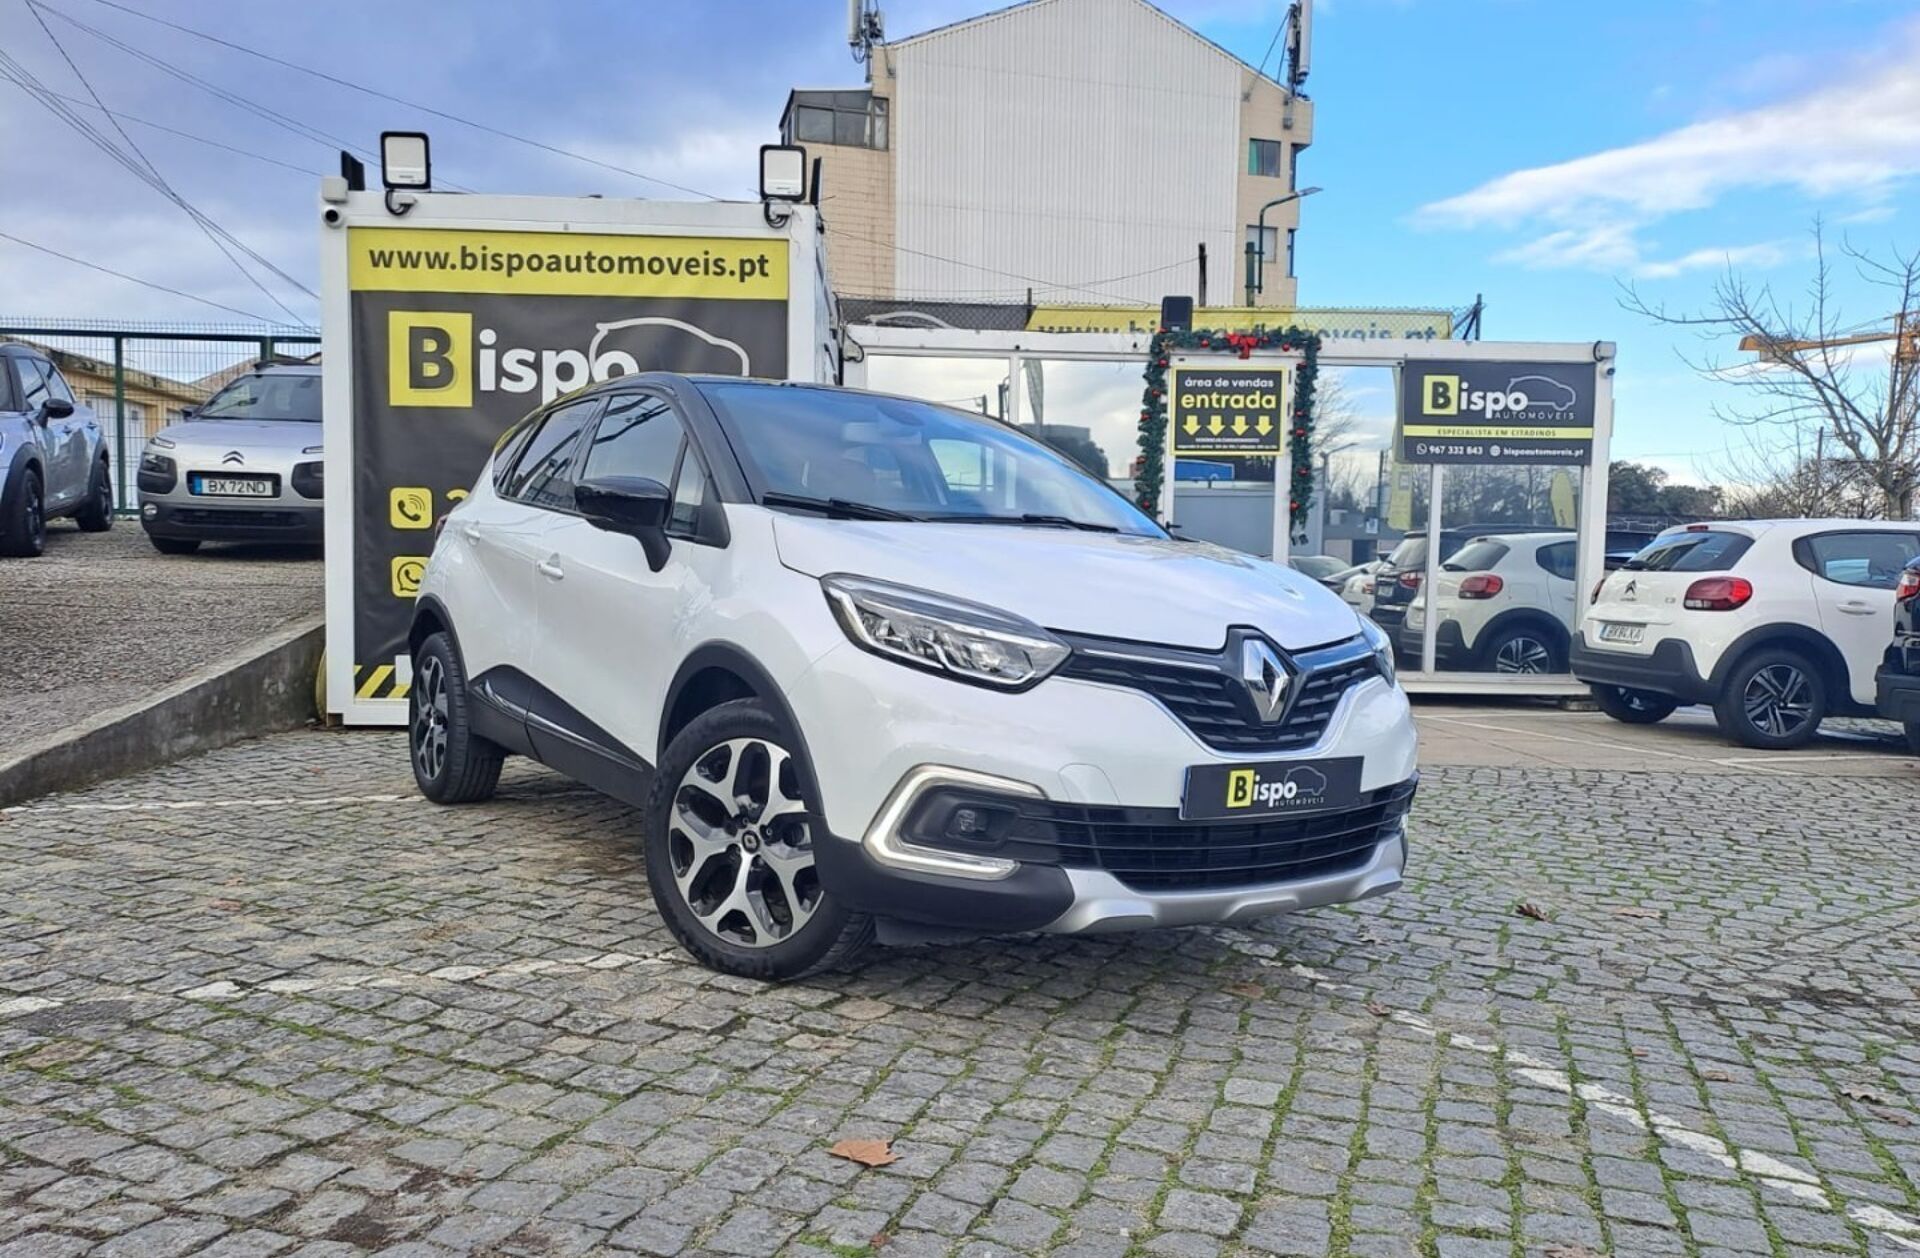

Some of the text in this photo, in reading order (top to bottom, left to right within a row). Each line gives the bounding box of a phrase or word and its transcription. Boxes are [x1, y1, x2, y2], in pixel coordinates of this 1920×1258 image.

[368, 245, 770, 282] www.bispoautomoveis.pt
[407, 325, 640, 400] Bispo
[1184, 376, 1275, 388] área de vendas
[1181, 390, 1277, 409] entrada
[1430, 381, 1529, 420] Bispo
[1437, 428, 1492, 436] ESPECIALISTA
[1511, 429, 1557, 437] CITADINOS
[1233, 775, 1298, 808] Bispo
